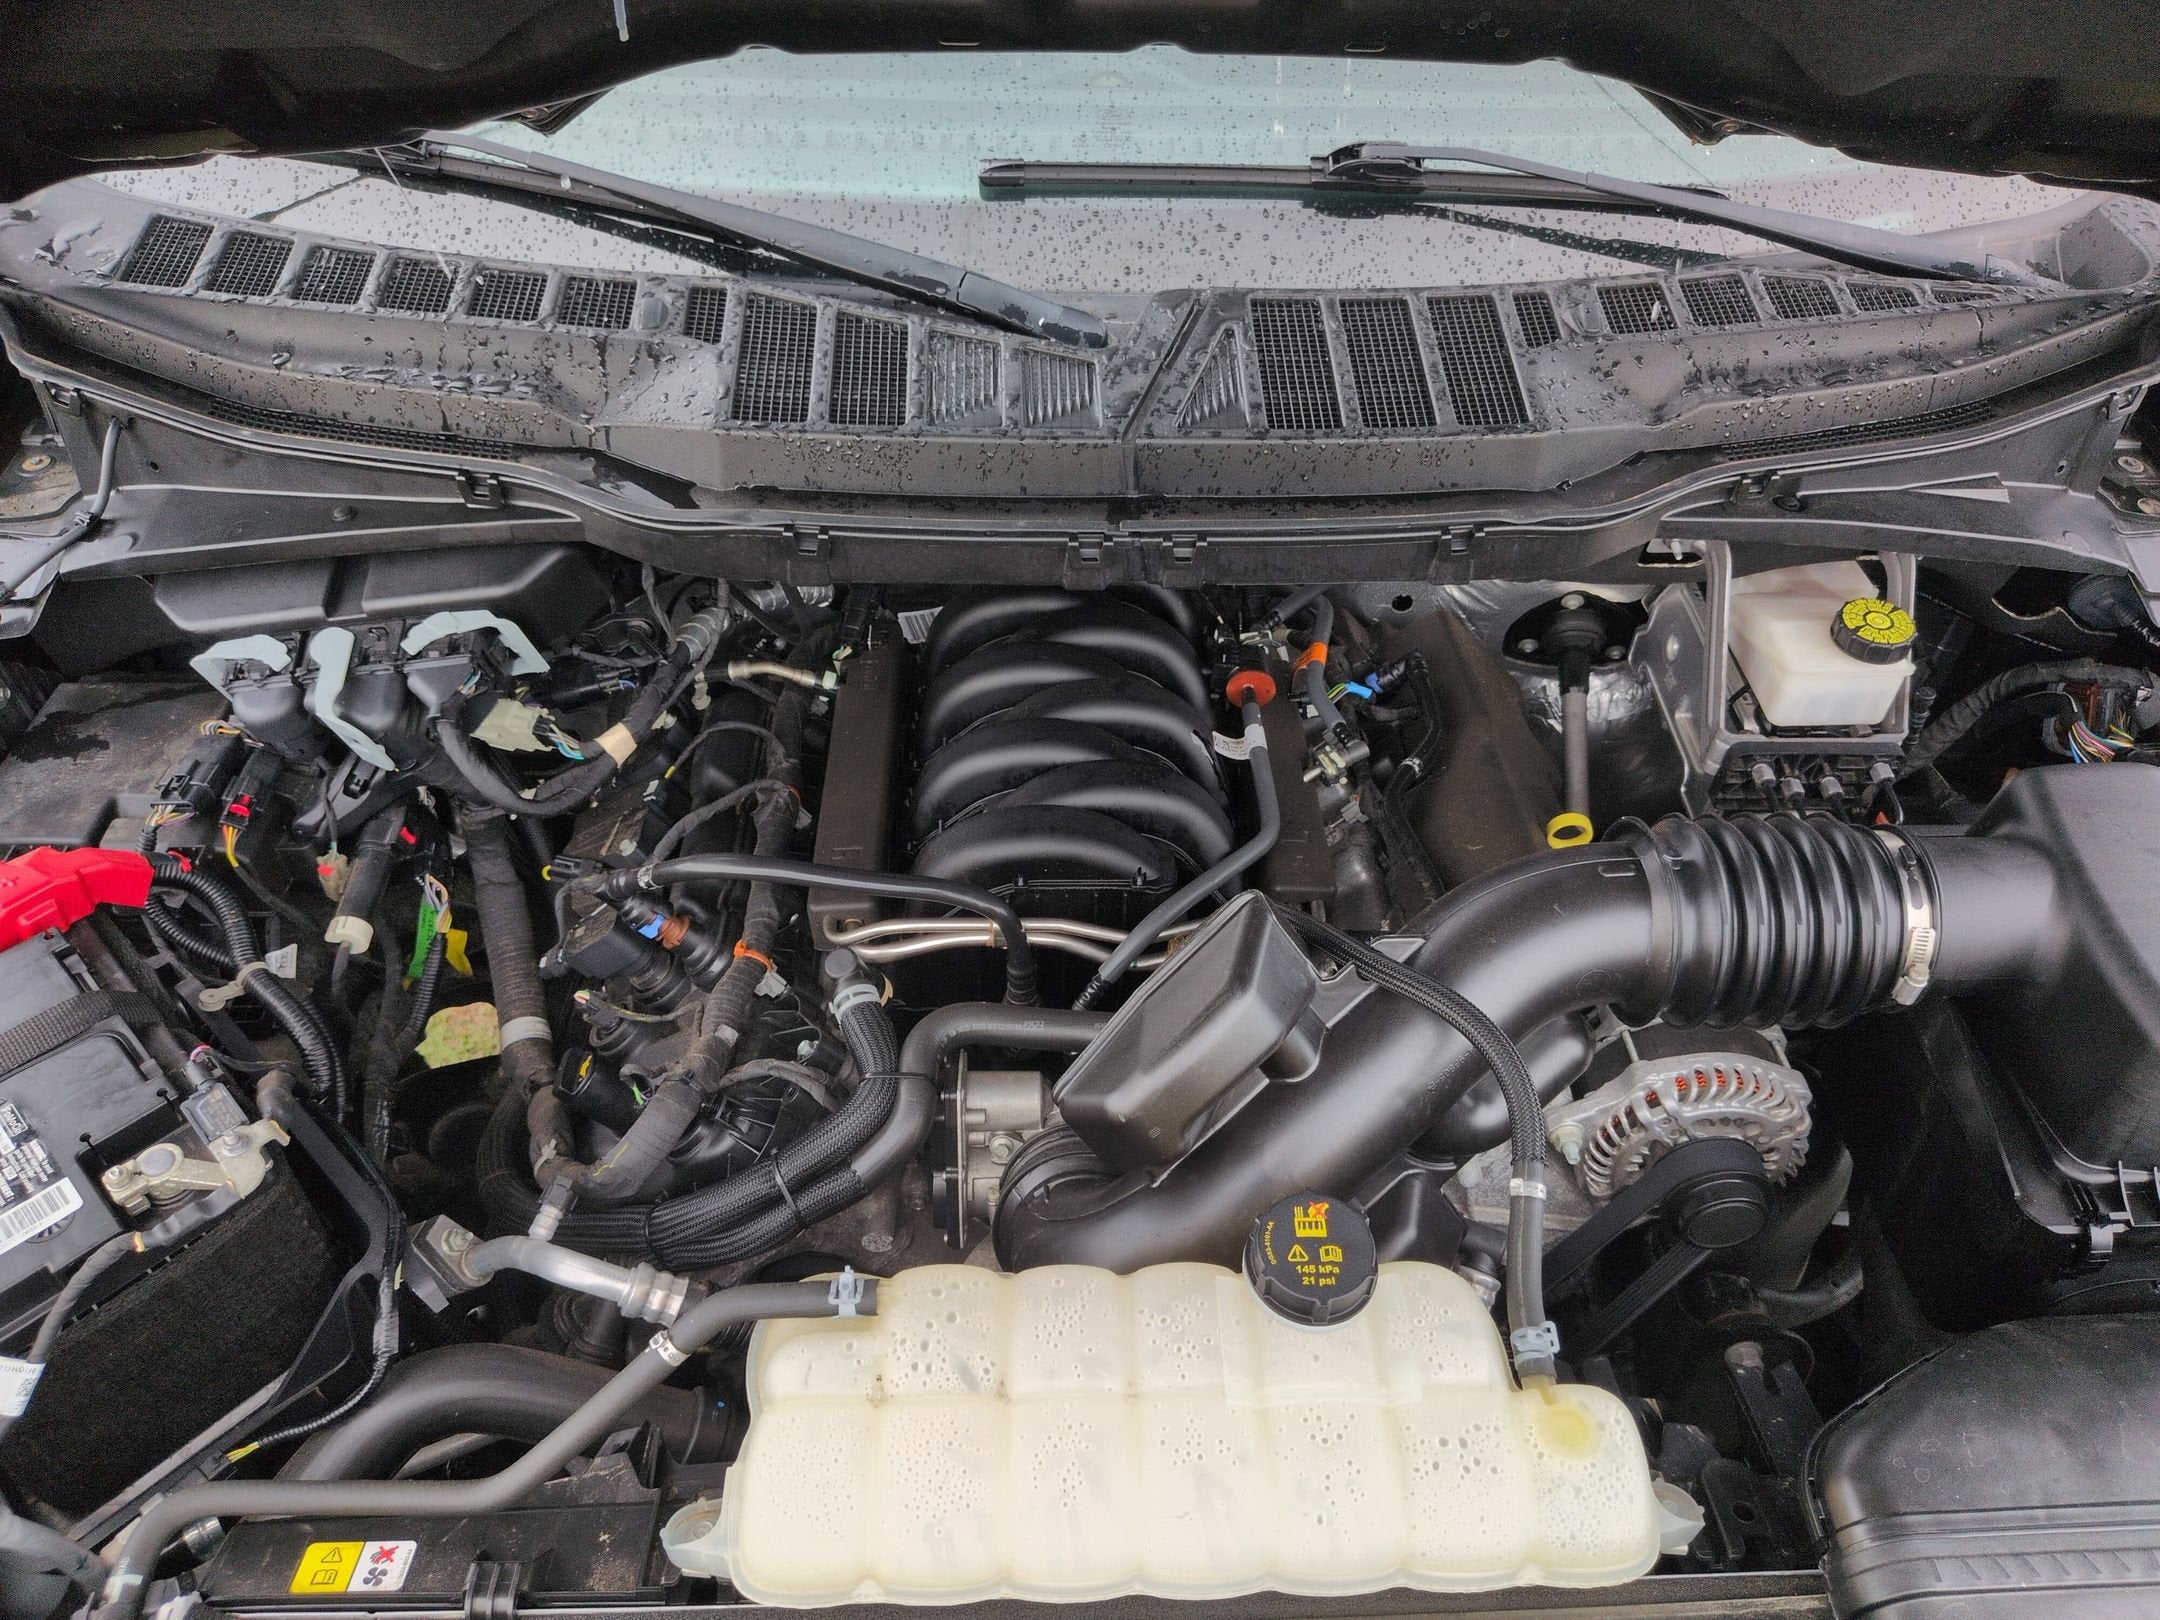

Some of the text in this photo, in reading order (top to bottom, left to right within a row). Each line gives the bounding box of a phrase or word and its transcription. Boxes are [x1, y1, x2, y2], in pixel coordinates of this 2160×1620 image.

[1, 1104, 23, 1135] FoMoCo
[1296, 1265, 1340, 1273] 145 kPa
[1302, 1276, 1336, 1287] 21 psi
